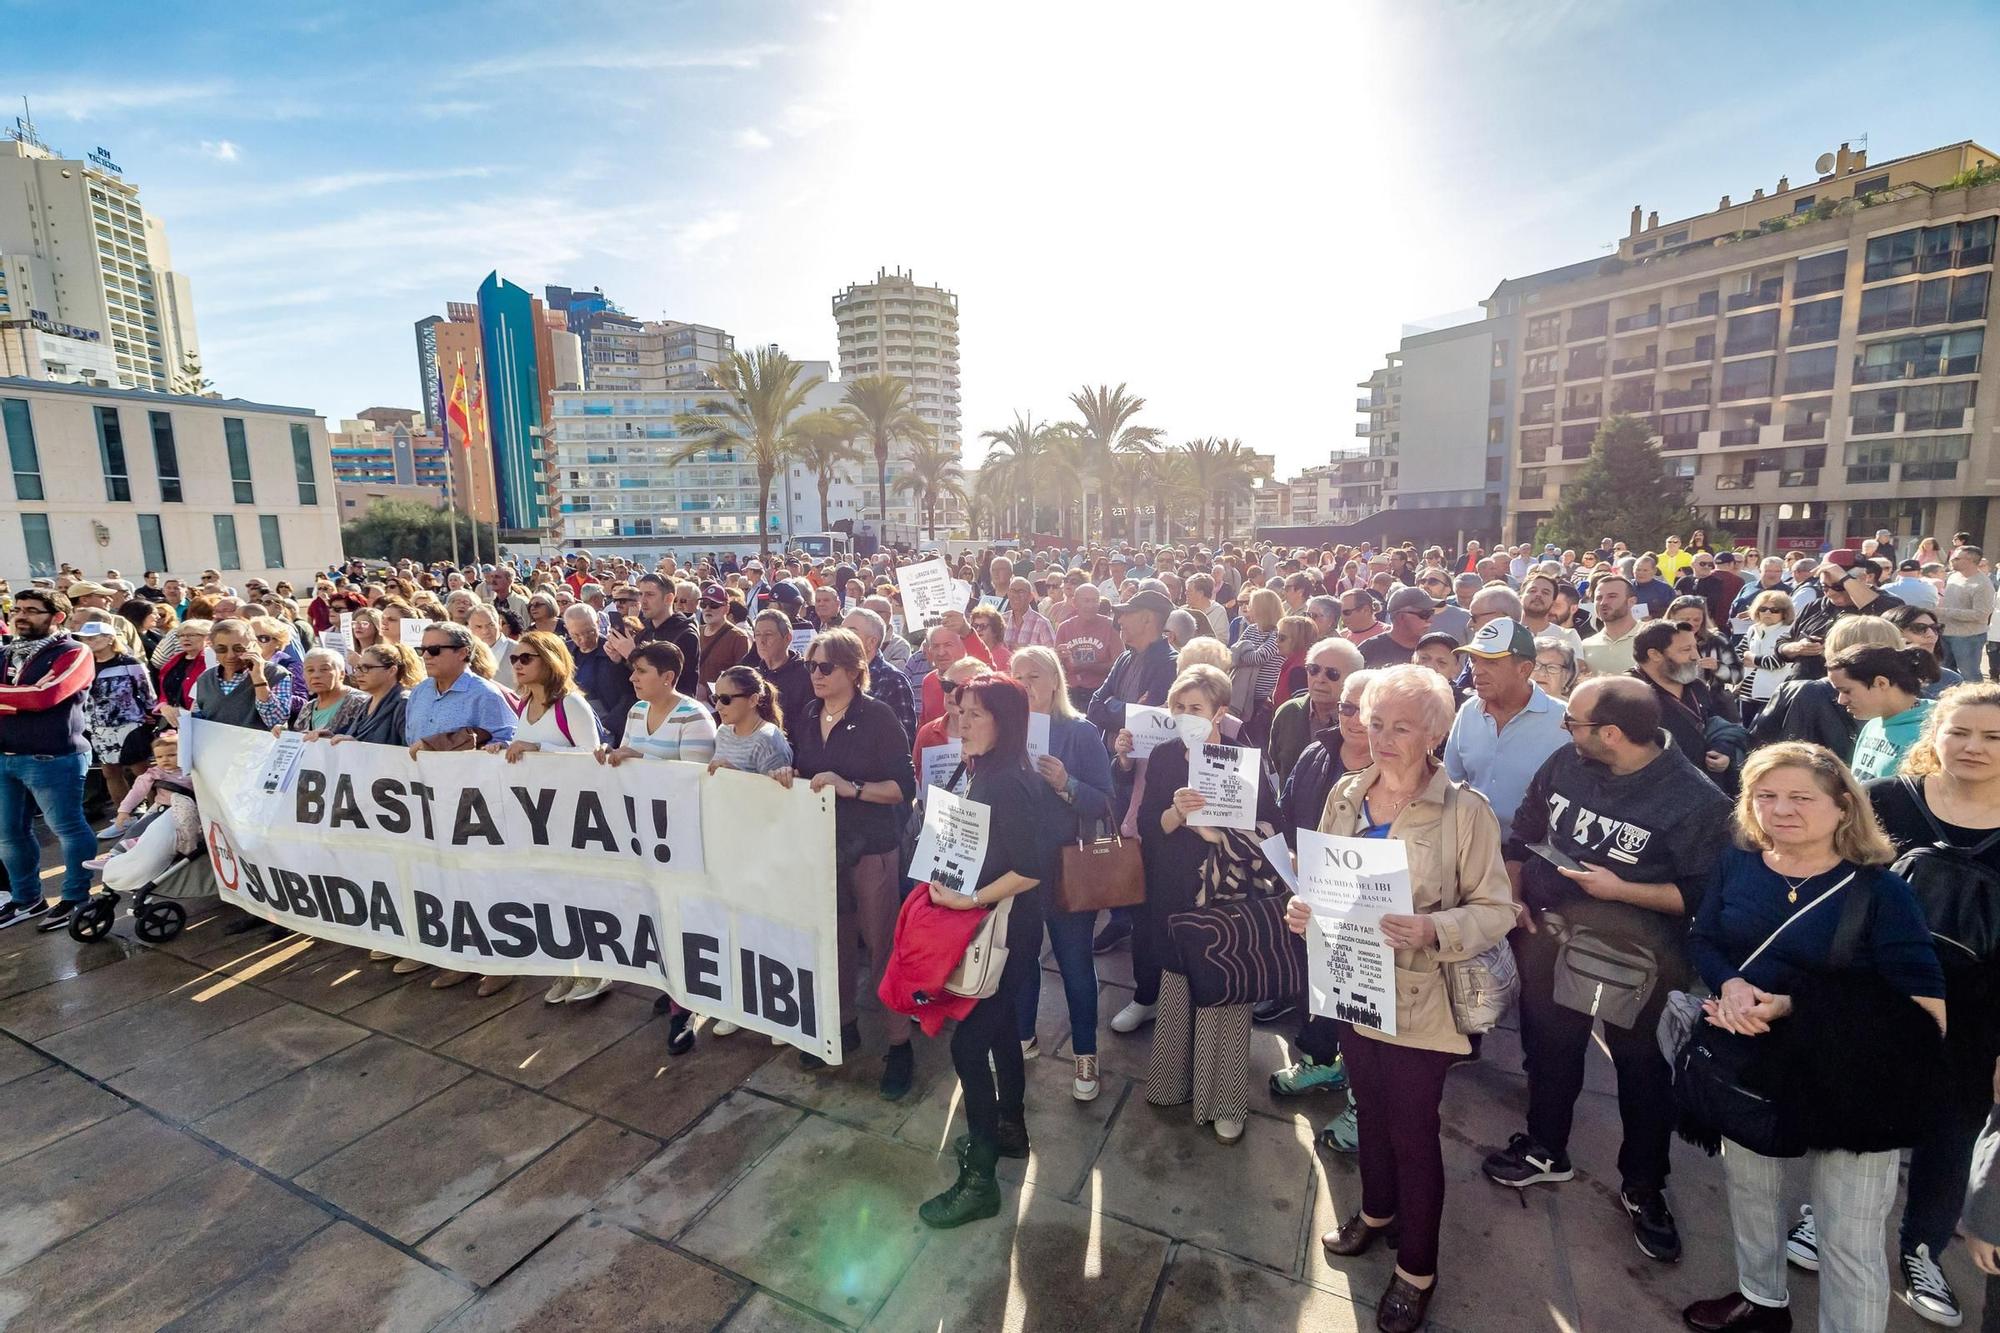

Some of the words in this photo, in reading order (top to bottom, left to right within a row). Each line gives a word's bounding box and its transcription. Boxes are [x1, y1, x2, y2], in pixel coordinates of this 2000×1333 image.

[1067, 636, 1104, 650] ENGLAND
[1151, 715, 1177, 730] NO
[296, 769, 504, 845] BASTA
[510, 786, 671, 863] YA!!
[1324, 846, 1363, 870] NO
[1324, 878, 1355, 889] SUBIDA
[1356, 881, 1374, 891] DEL
[1374, 882, 1392, 892] IBI
[1361, 894, 1393, 903] BASURA
[238, 855, 405, 936] SUBIDA
[413, 890, 667, 979] BASURA
[682, 932, 722, 1001] E
[740, 948, 817, 1038] IBI
[1331, 942, 1353, 953] CONTRA
[1331, 955, 1349, 965] SUBIDA
[1334, 962, 1355, 973] BASURA
